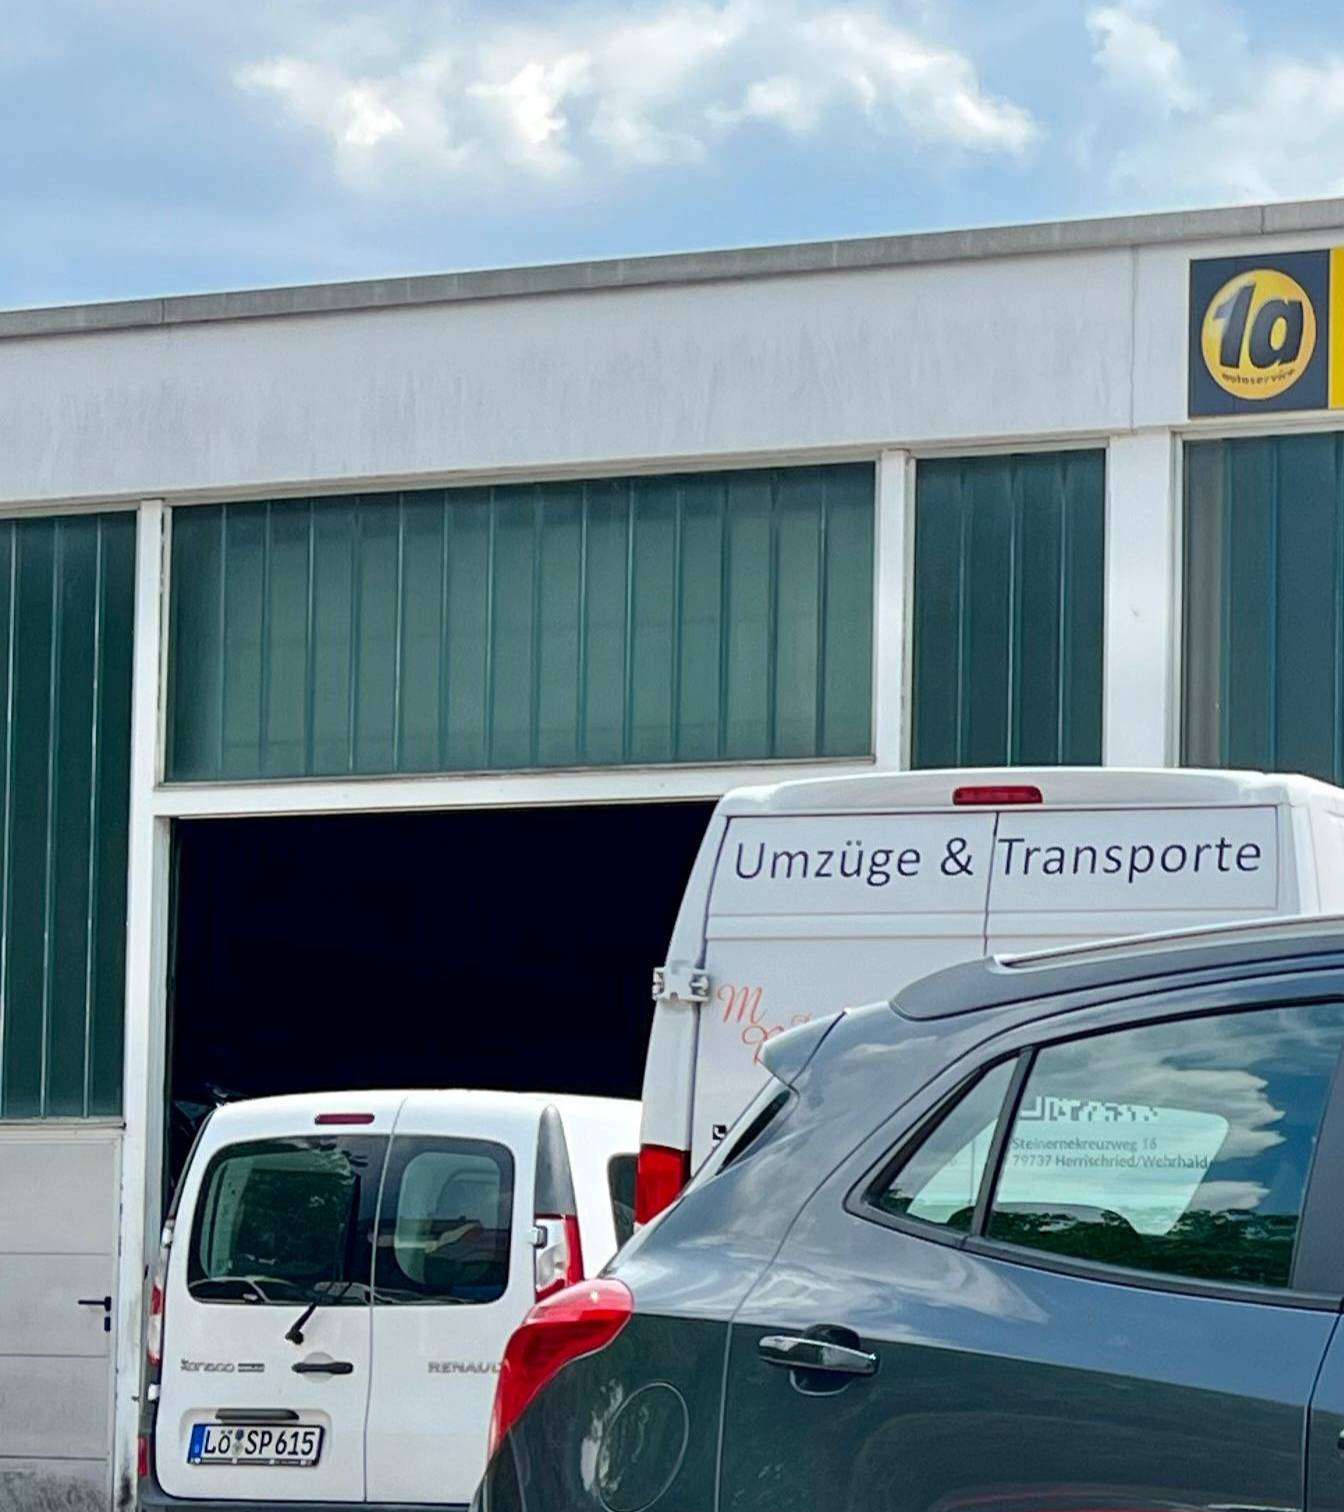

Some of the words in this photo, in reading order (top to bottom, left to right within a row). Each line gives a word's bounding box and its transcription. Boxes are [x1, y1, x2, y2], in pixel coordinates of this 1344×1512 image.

[1213, 284, 1305, 369] 1a
[735, 841, 921, 887] Umzüge
[939, 837, 974, 877] &
[998, 837, 1263, 882] Transporte
